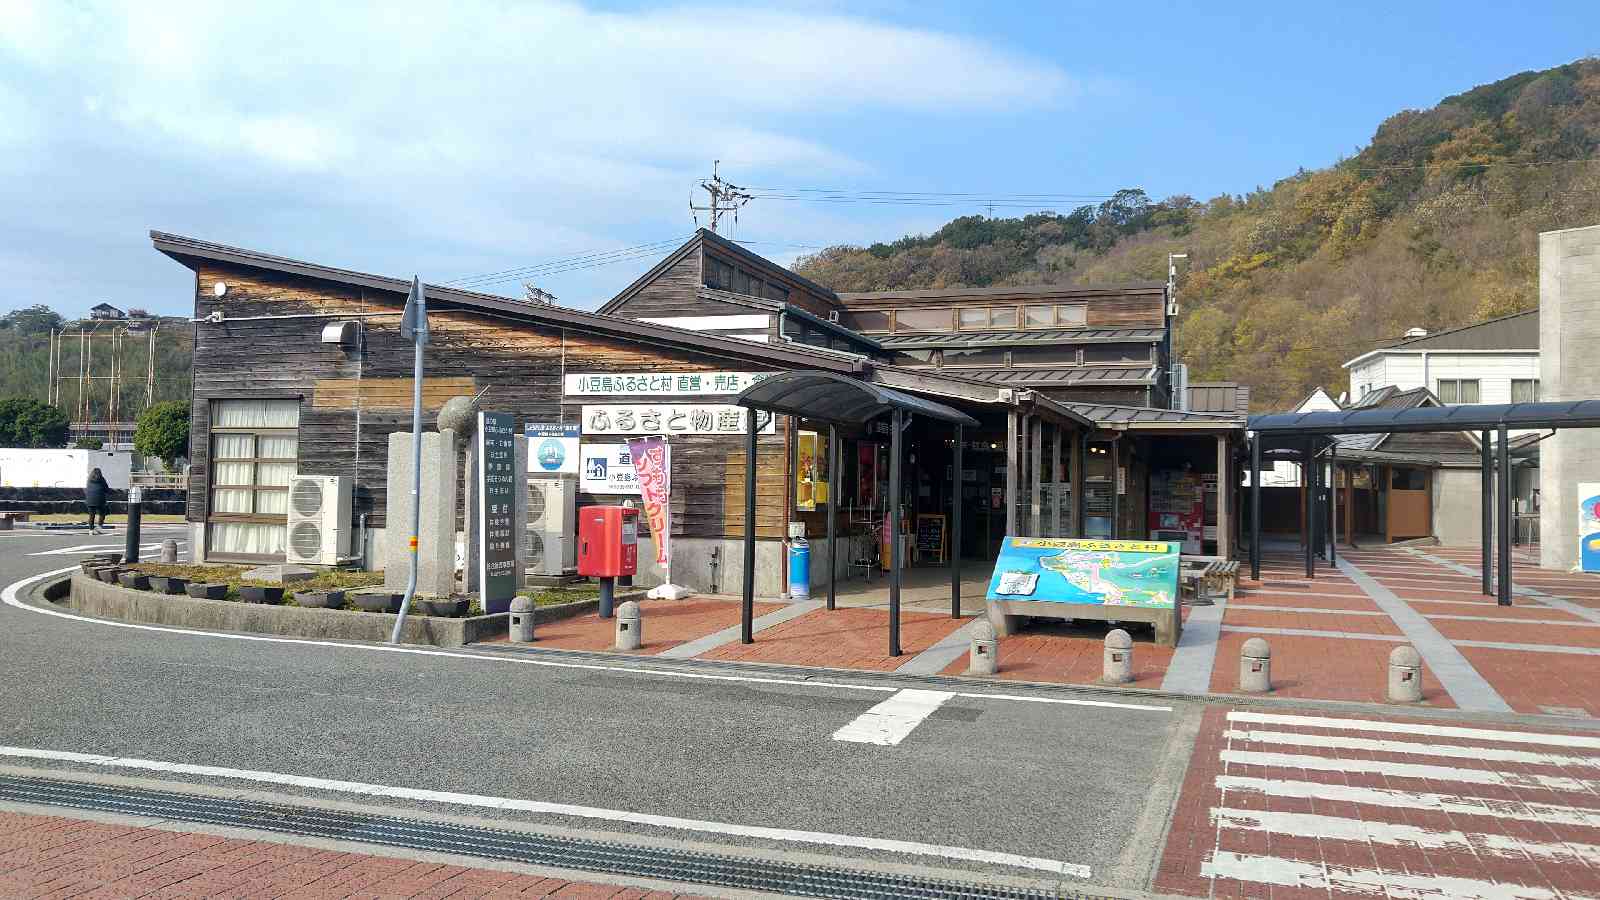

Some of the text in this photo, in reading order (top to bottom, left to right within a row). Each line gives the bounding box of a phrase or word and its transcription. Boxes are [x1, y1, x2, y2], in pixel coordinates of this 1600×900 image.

[578, 375, 771, 392] 小豆島ふるさと村 直営・売店・
